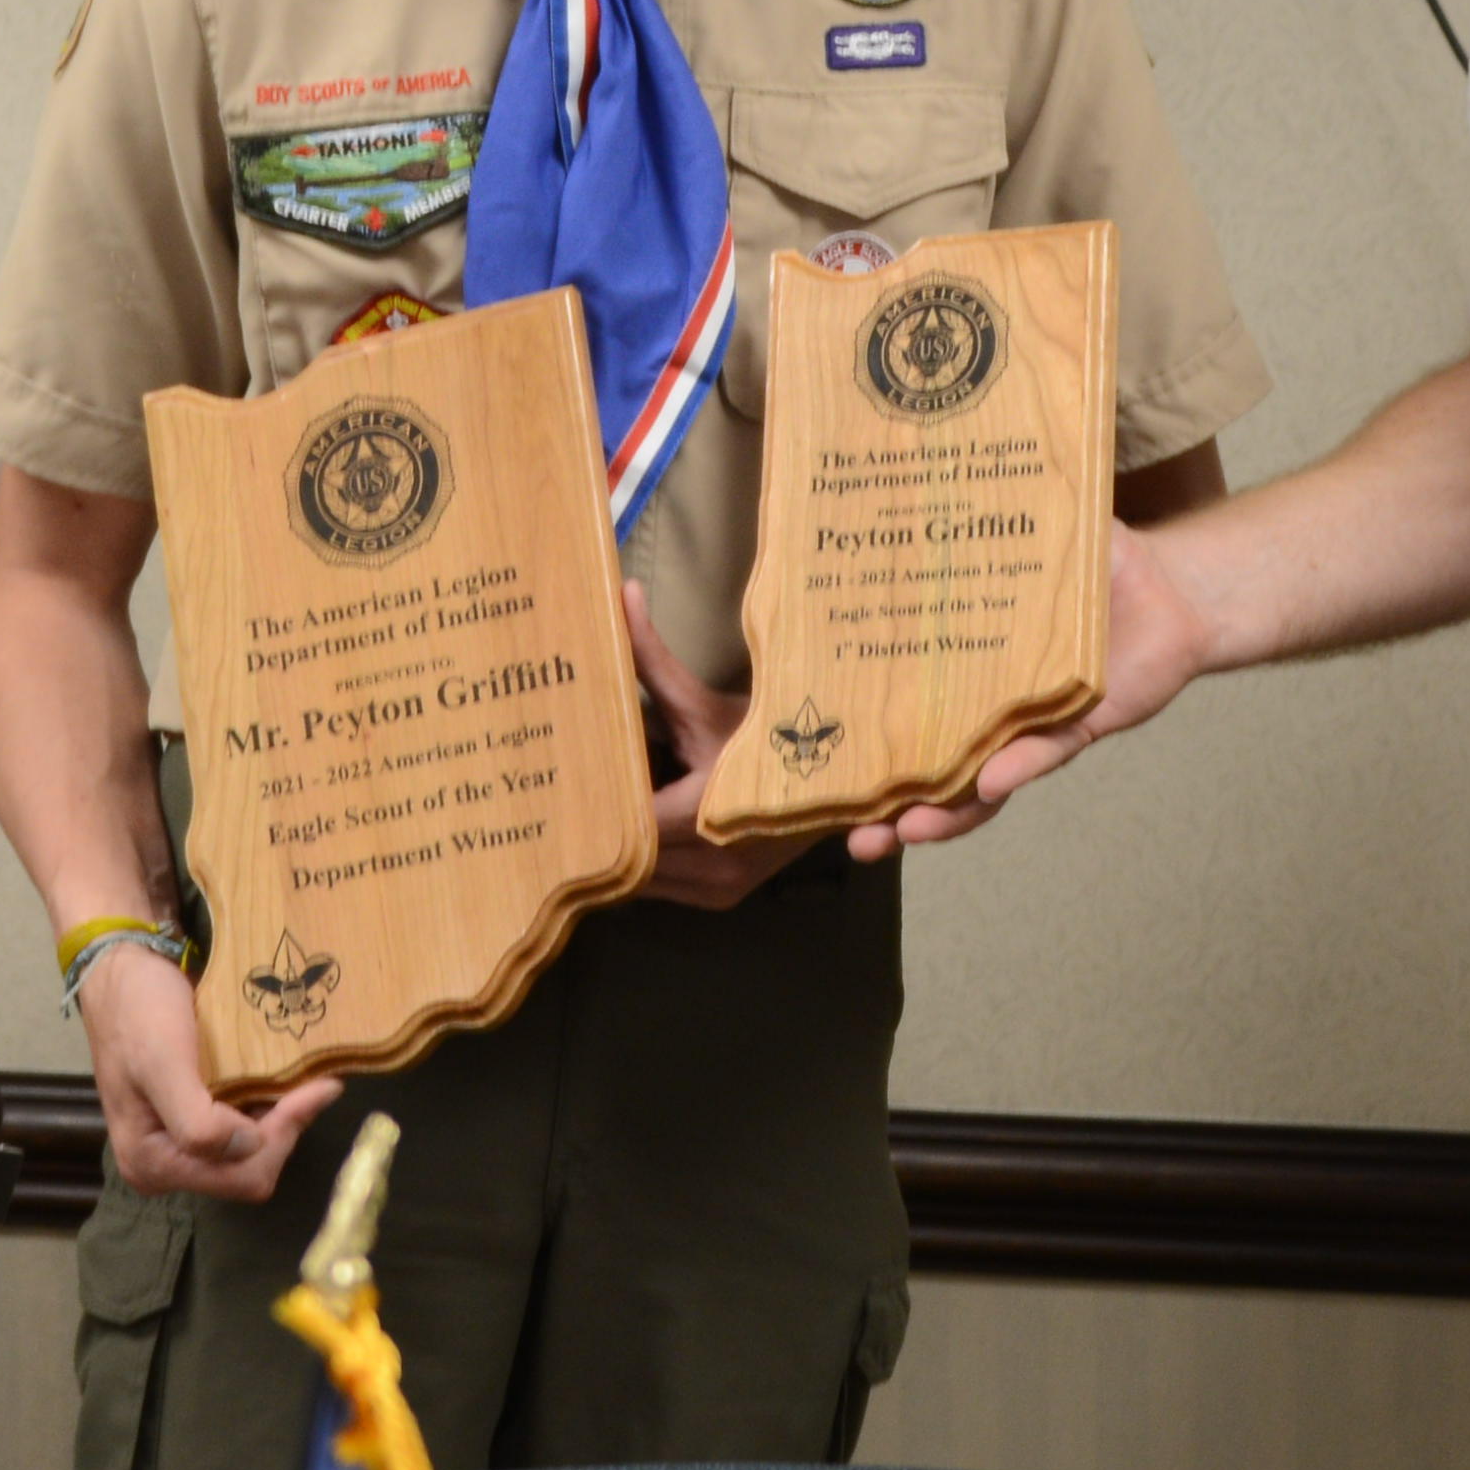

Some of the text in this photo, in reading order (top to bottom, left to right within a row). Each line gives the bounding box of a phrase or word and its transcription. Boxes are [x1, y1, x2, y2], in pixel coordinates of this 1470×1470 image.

[256, 83, 291, 105] BOY
[297, 77, 365, 104] SCOUTS
[396, 66, 471, 97] AMERICA
[317, 133, 417, 159] TAKHONE
[273, 196, 349, 232] CHARTER
[876, 286, 991, 339] AMERICAN
[920, 338, 944, 361] US
[887, 381, 973, 411] LEGION
[304, 410, 430, 478] AMERICAN
[819, 437, 1038, 469] The American Legion
[357, 467, 383, 494] US
[811, 461, 1044, 496] Department of Indiana
[330, 512, 423, 552] LEGION
[816, 512, 1036, 557] Peyton Griffith
[806, 573, 842, 591] 2021
[858, 567, 897, 587] 2022
[902, 563, 981, 583] American
[987, 557, 1044, 578] Legion
[245, 564, 518, 642] The American Legion
[828, 595, 1017, 624] Eagle Scout of the Year
[246, 592, 535, 674] Department of Indiana
[858, 639, 930, 658] District
[936, 633, 1008, 654] Winner
[335, 663, 426, 694] PRESENTED
[225, 654, 576, 759] Mr. Peyton Griffith
[260, 774, 305, 801] 2021
[326, 758, 373, 787] 2022
[380, 740, 479, 774] American
[485, 720, 554, 750] Legion
[268, 766, 559, 846] Eagle Scout of the Year
[292, 818, 548, 891] Department Winner
